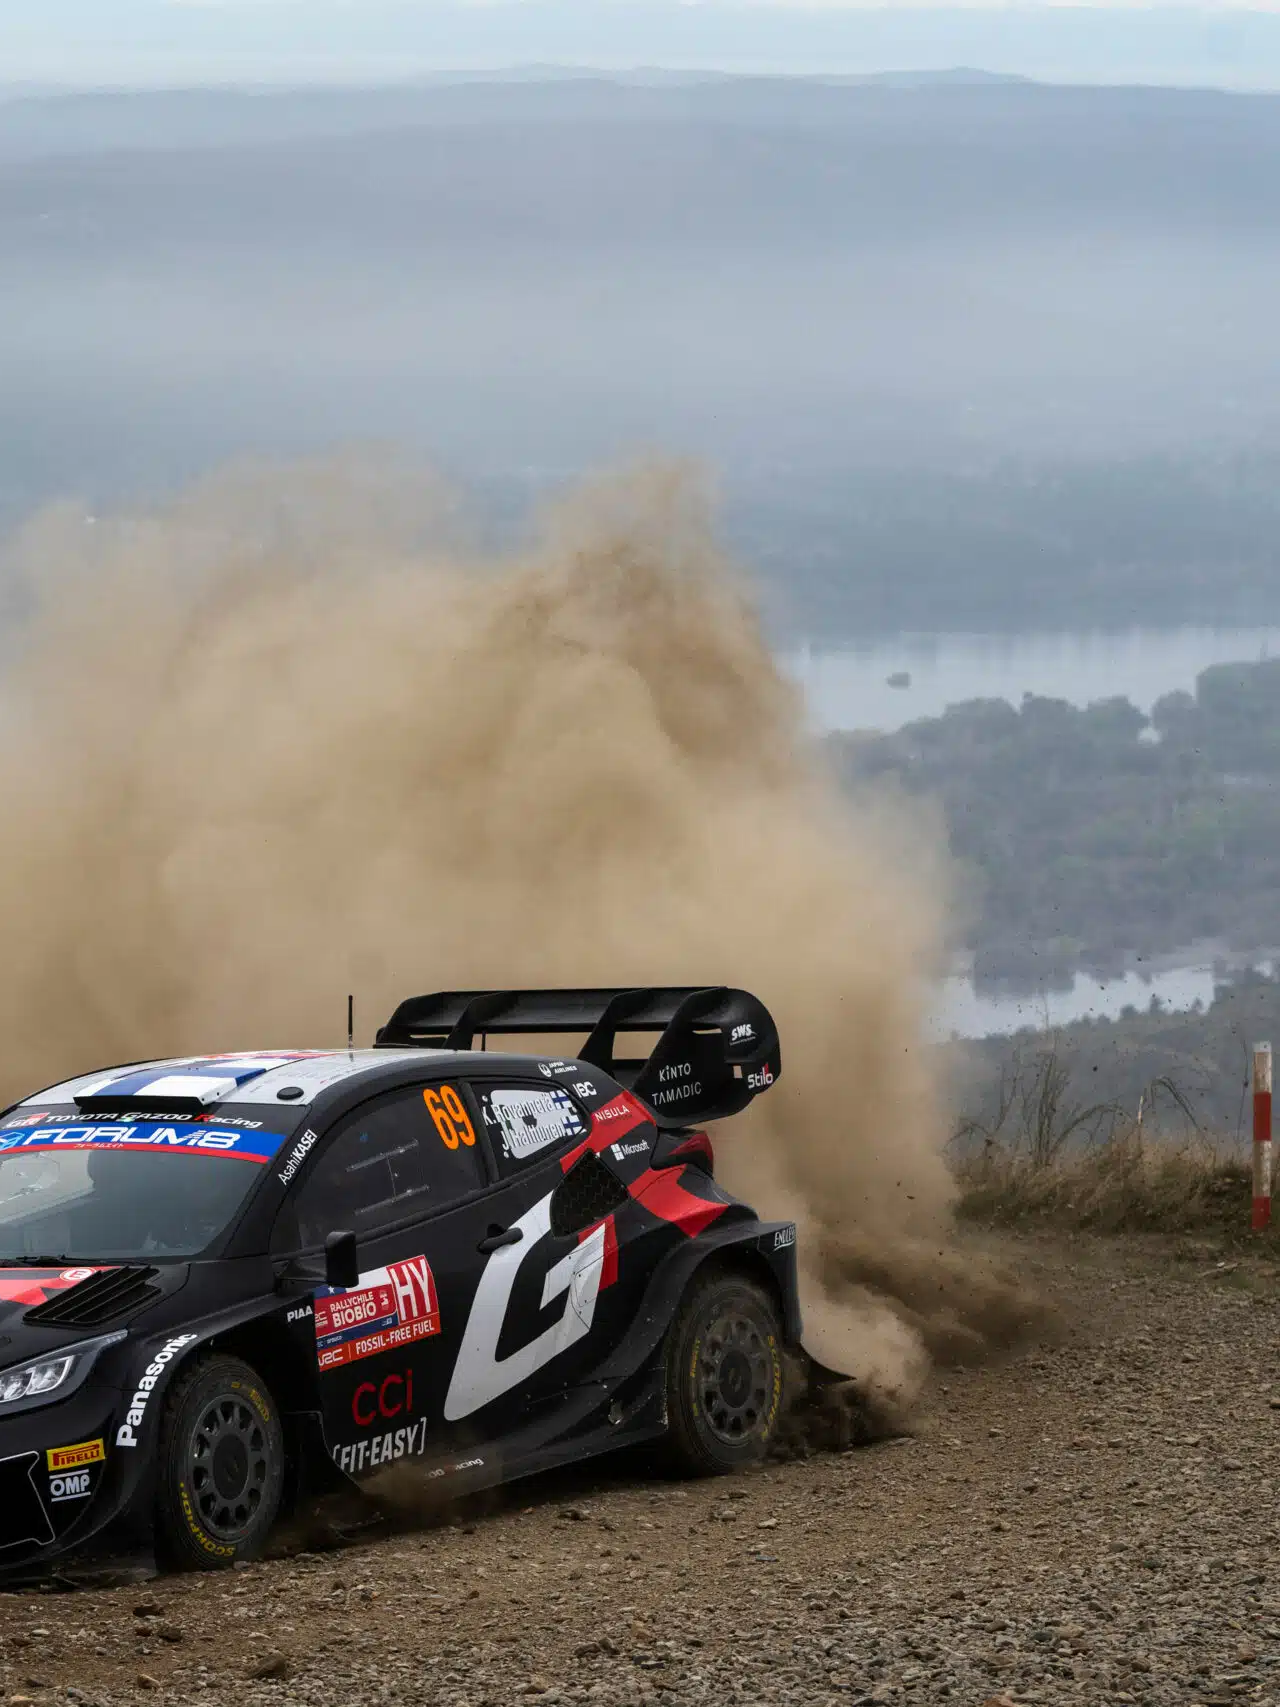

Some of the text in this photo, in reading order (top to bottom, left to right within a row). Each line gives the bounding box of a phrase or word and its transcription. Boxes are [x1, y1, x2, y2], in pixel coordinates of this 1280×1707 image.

[731, 1024, 753, 1041] SWS
[747, 1062, 774, 1089] Stilo
[652, 1081, 702, 1106] TAMADIC
[46, 1112, 118, 1124] TOYOTA
[117, 1112, 193, 1123] GAZOO
[193, 1114, 264, 1129] Racing
[423, 1085, 476, 1150] 69
[594, 1104, 631, 1122] NISULA
[23, 1126, 242, 1149] FORUM8
[621, 1139, 650, 1156] Microsoft
[389, 1259, 432, 1321] HY
[287, 1305, 313, 1322] PIAA
[355, 1326, 412, 1355] FOSSIL-FREE
[413, 1319, 435, 1336] FUEL
[116, 1333, 198, 1447] Panasonic
[53, 1443, 101, 1467] PIRELLI
[50, 1474, 91, 1497] OMP
